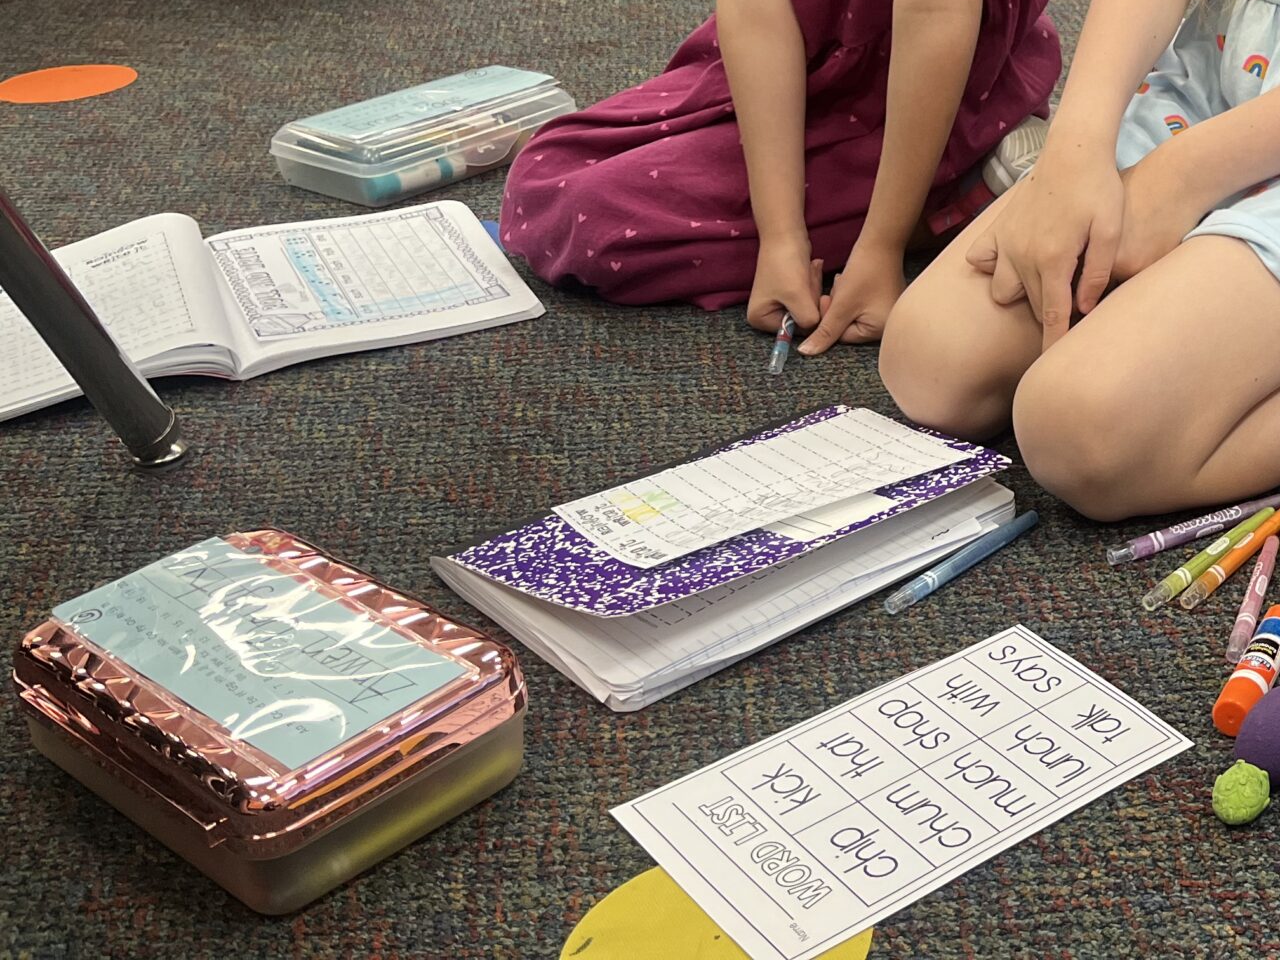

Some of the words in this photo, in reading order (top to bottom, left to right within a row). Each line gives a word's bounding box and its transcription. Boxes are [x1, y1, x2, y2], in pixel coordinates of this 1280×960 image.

[303, 636, 417, 704] Arwen
[988, 644, 1062, 693] says
[937, 673, 1001, 717] with
[878, 699, 951, 750] shop
[1076, 703, 1132, 744] talk
[816, 731, 885, 779] that
[1006, 724, 1092, 788] lunch
[752, 762, 822, 816] kick
[944, 752, 1036, 818] much
[697, 795, 768, 846] LIST
[886, 783, 972, 848] chum
[750, 840, 833, 910] WORD
[830, 827, 899, 878] chip
[788, 922, 811, 943] Name
